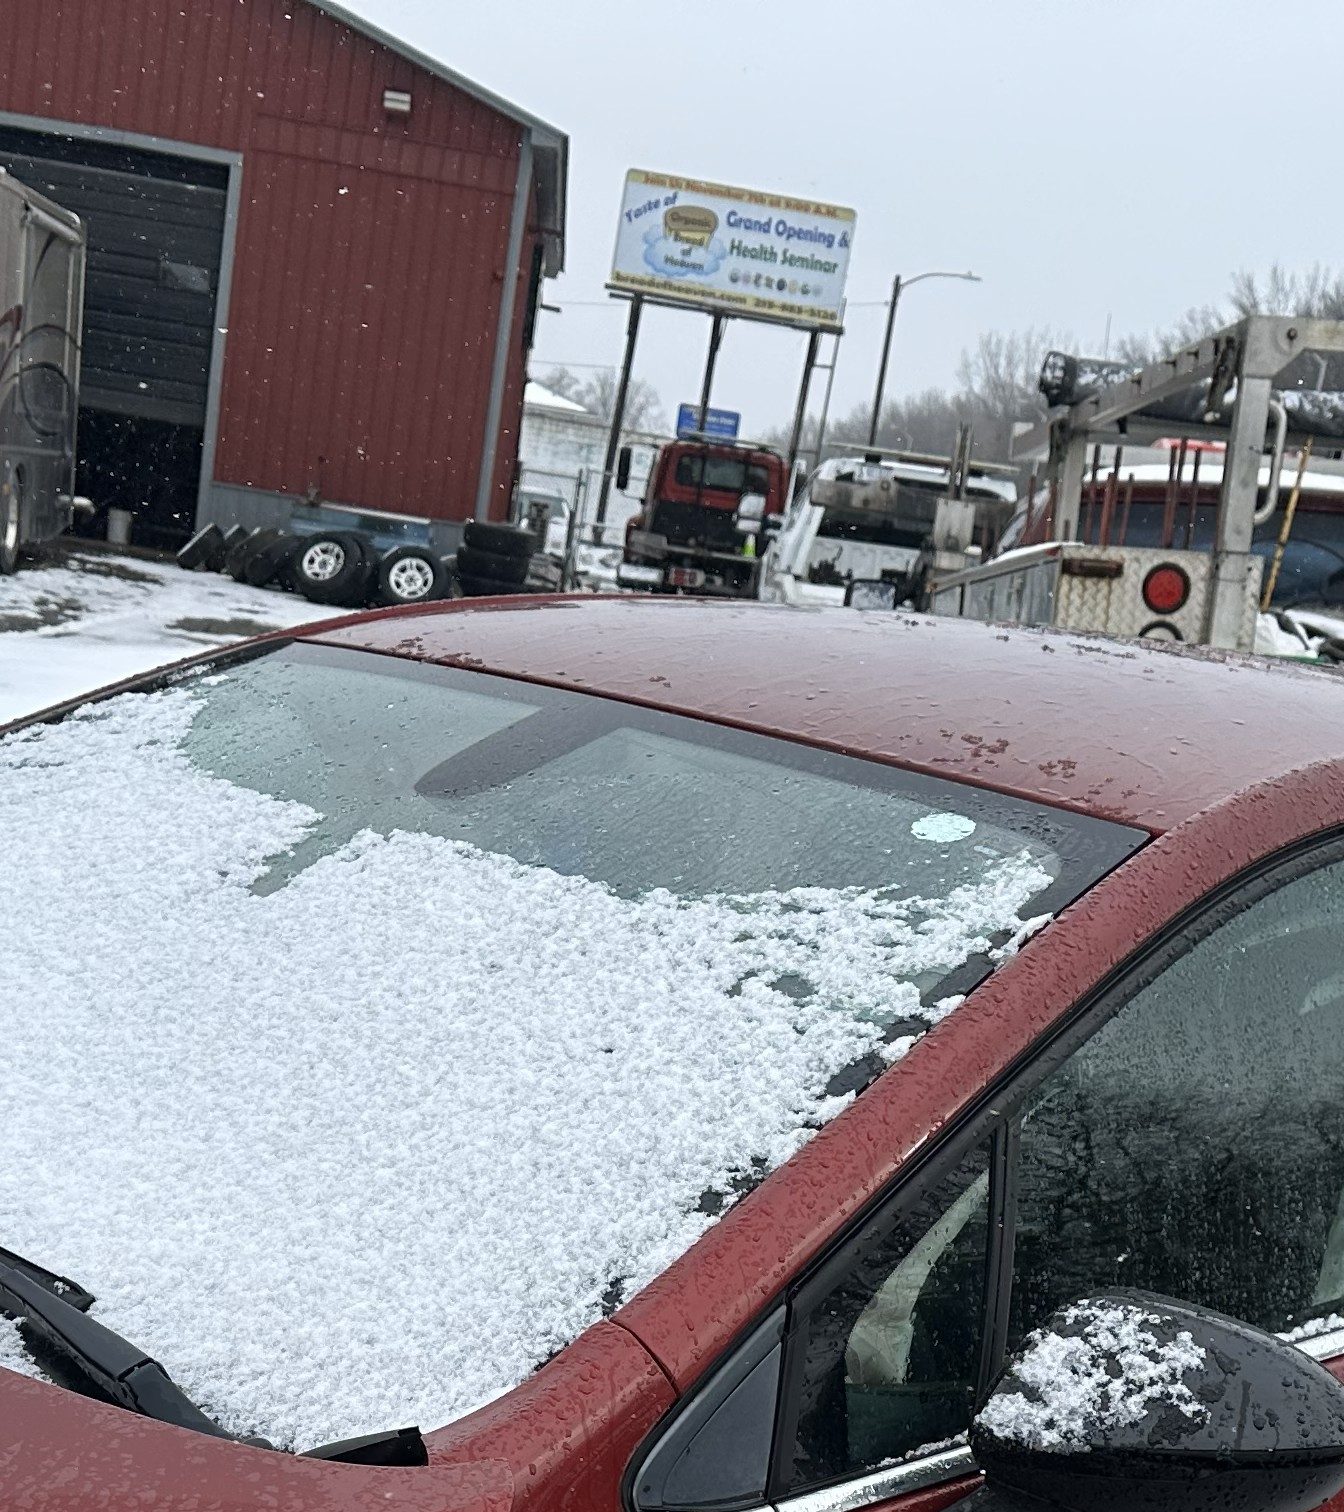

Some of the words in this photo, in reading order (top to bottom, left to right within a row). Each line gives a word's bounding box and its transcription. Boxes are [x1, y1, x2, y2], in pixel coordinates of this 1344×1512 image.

[625, 198, 661, 223] Taste
[663, 191, 679, 206] of
[670, 211, 712, 228] Organic
[673, 230, 705, 246] Bread
[726, 210, 772, 234] Grand
[775, 219, 836, 249] Opening
[838, 229, 850, 249] &
[680, 246, 693, 257] of
[729, 238, 778, 264] Health
[780, 248, 839, 274] Seminar
[663, 254, 704, 271] Heaven
